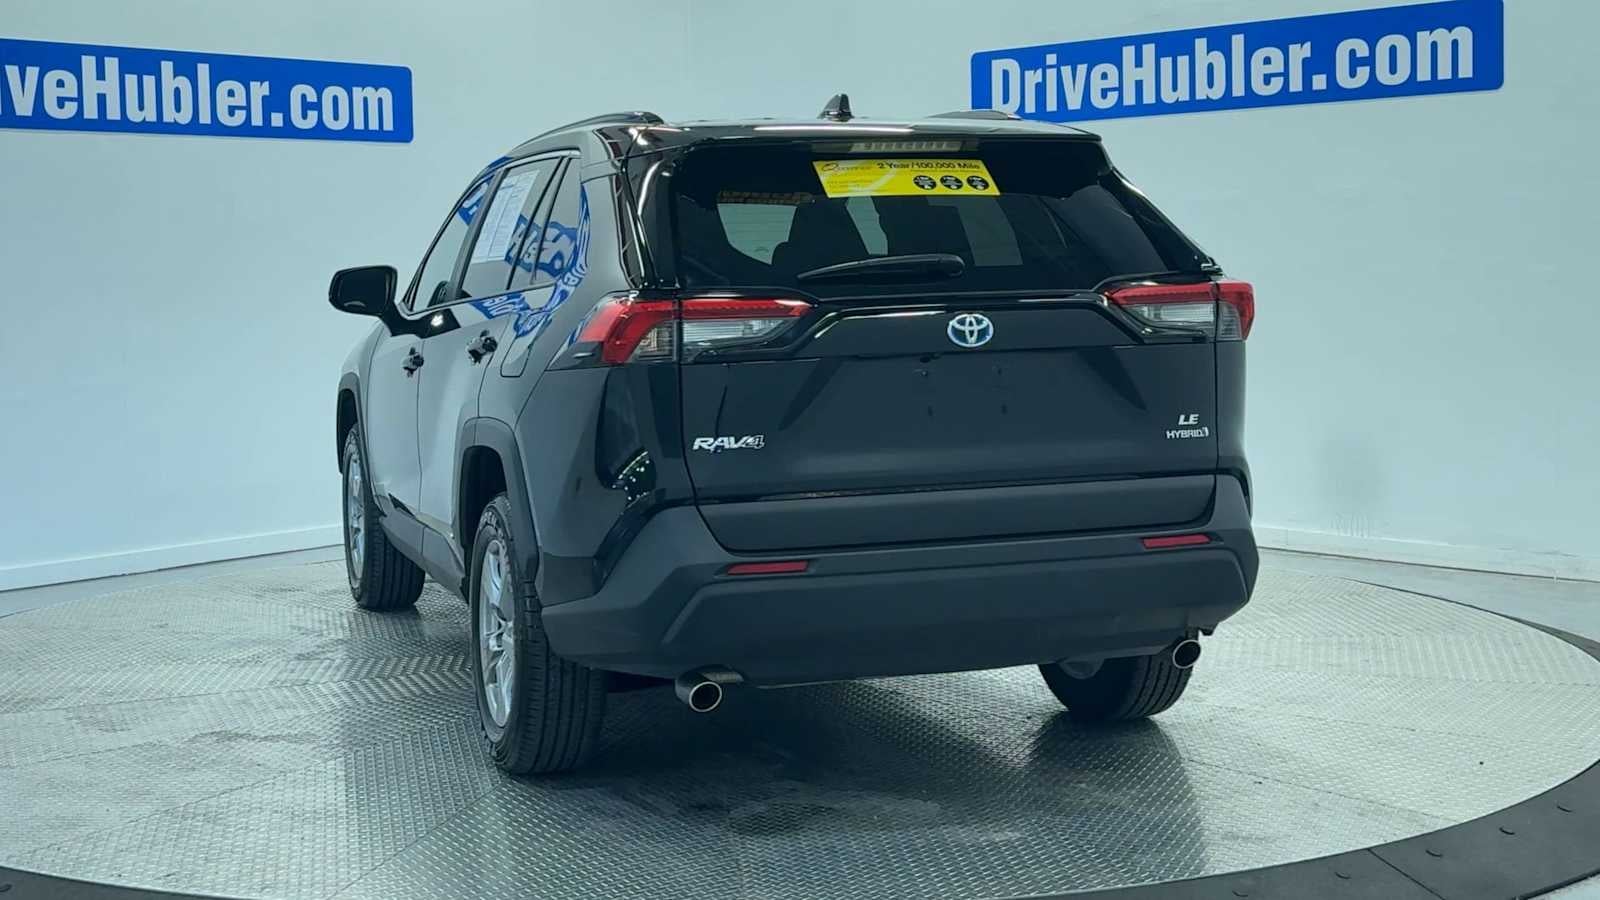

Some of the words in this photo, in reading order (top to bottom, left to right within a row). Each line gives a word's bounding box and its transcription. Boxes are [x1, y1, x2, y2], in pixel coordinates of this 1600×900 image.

[0, 54, 395, 131] veHubler.com
[990, 26, 1474, 113] DriveHubler.com
[1178, 414, 1200, 425] LE
[693, 435, 765, 452] RAV4
